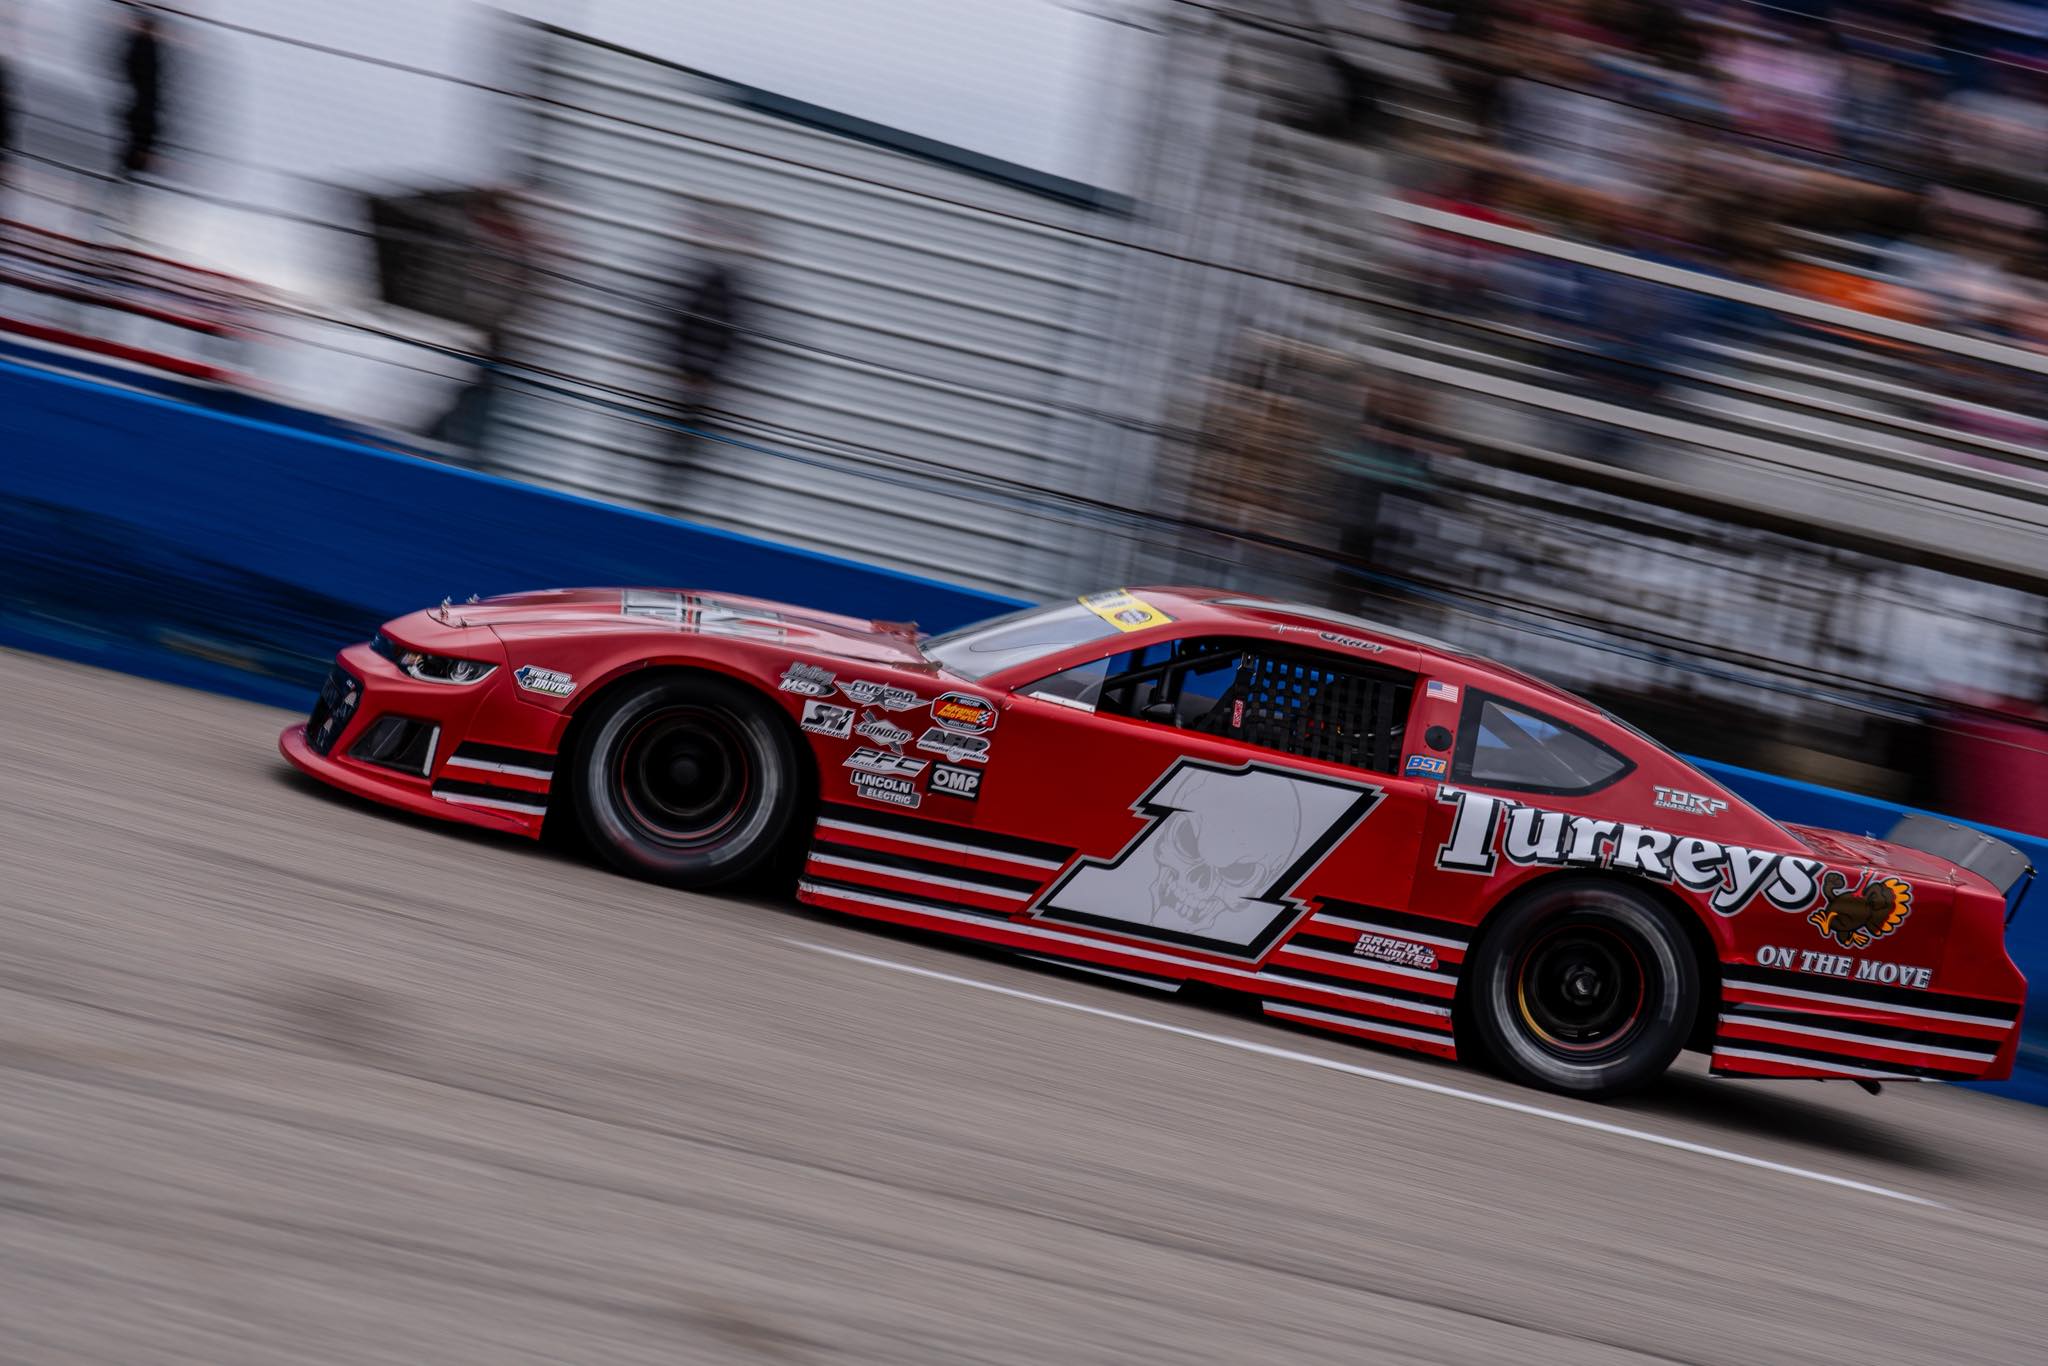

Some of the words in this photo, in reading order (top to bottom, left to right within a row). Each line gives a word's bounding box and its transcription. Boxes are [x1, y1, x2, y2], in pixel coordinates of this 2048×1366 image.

[779, 679, 821, 694] MSD
[851, 682, 881, 694] FIVE
[886, 688, 914, 702] STAR
[801, 725, 849, 739] PERFORMANCE
[860, 723, 910, 741] SUNOCO
[921, 729, 989, 752] ARP
[1407, 755, 1446, 773] BST
[854, 772, 911, 793] LINCOLN
[932, 769, 979, 792] OMP
[866, 787, 912, 804] ELECTRIC
[1026, 755, 1389, 964] 1
[1435, 784, 1827, 917] Turkeys
[1355, 942, 1435, 964] UNLIMITED
[1359, 933, 1424, 954] GRAFIX
[1757, 945, 1797, 969] ON
[1801, 951, 1853, 977] THE
[1854, 960, 1932, 989] MOVE
